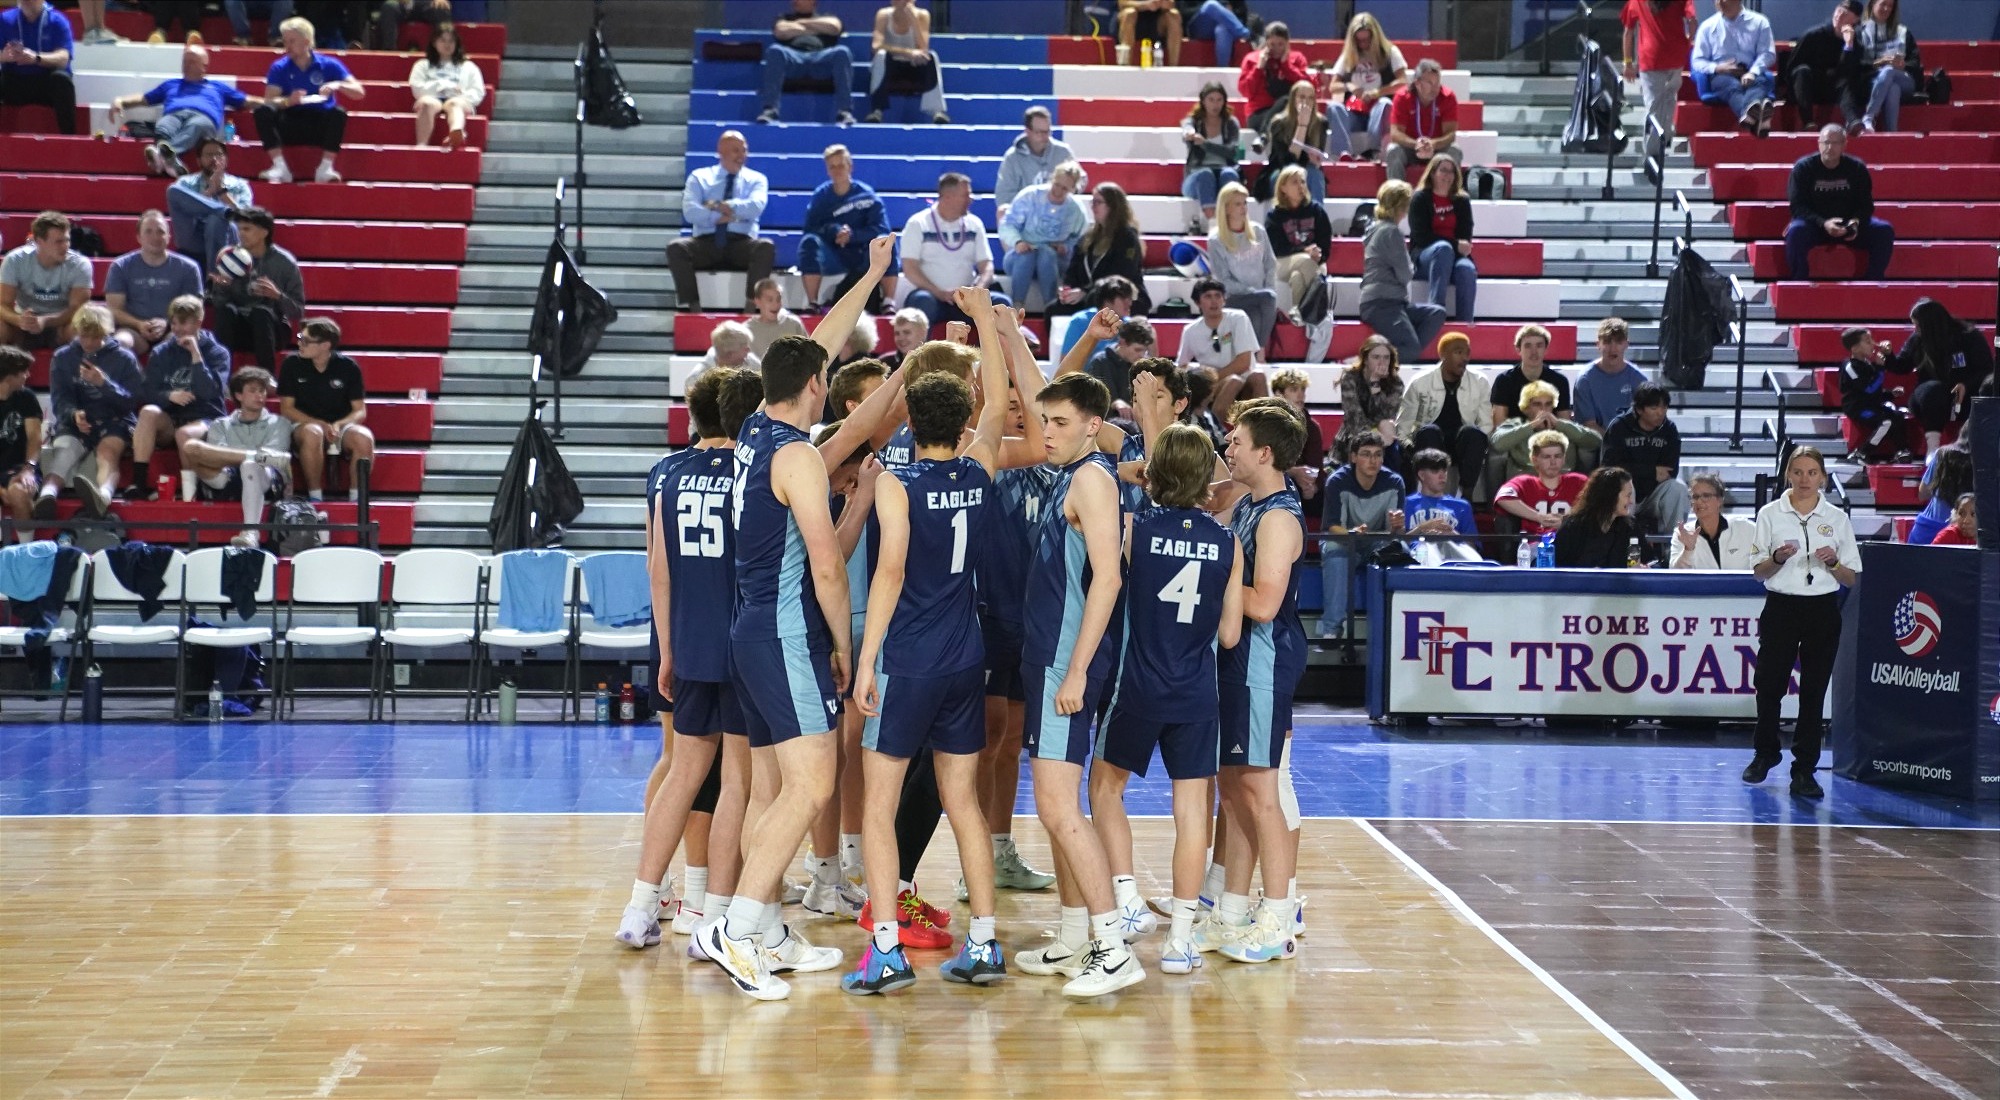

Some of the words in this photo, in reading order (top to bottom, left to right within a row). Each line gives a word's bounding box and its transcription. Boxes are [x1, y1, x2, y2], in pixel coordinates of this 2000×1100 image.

[678, 474, 734, 493] EAGLES
[926, 487, 983, 510] EAGLES
[677, 491, 726, 558] 25
[950, 508, 968, 575] 1
[1150, 536, 1220, 562] EAGLES
[1156, 560, 1202, 625] 4
[1562, 614, 1650, 636] HOME
[1661, 616, 1699, 637] OF
[1510, 641, 1801, 696] TROJAN
[1980, 775, 2000, 784] sport
